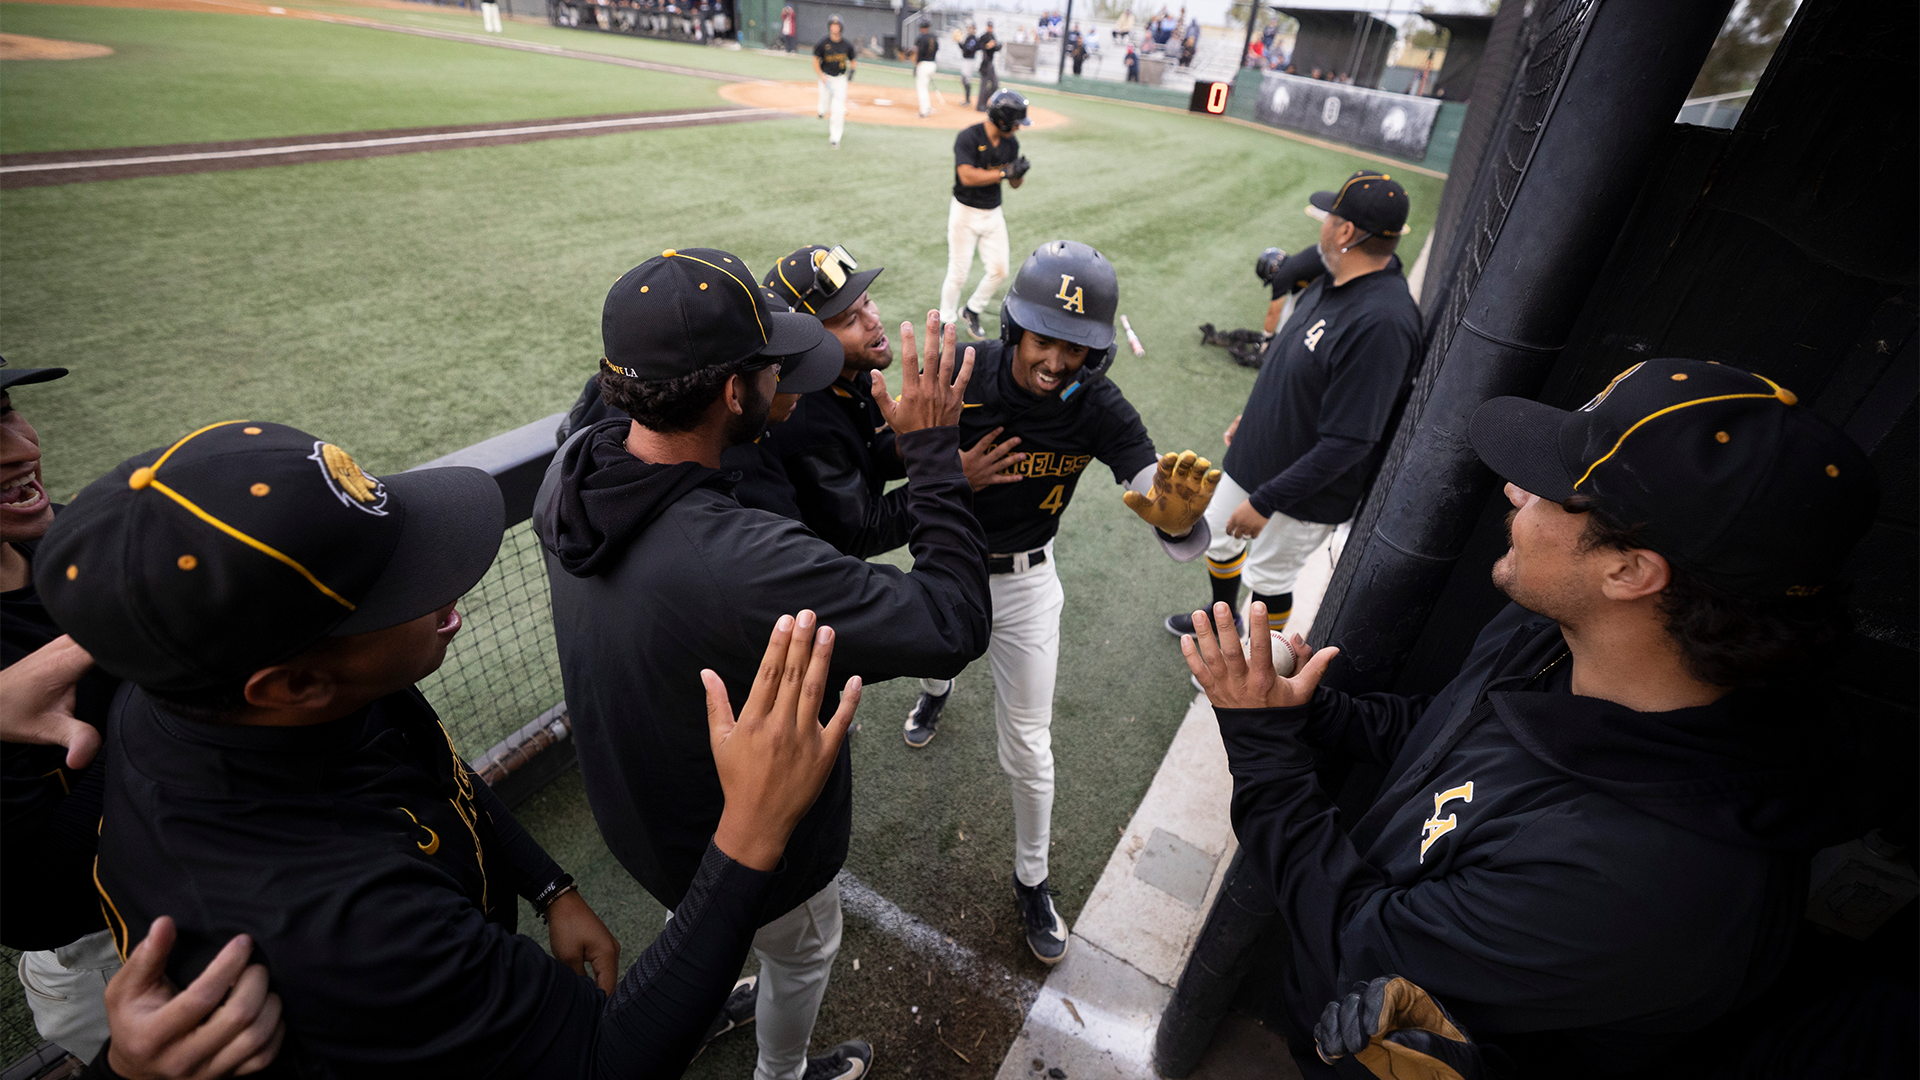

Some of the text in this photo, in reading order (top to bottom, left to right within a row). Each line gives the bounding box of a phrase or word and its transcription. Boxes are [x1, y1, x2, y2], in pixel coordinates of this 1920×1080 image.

[1206, 81, 1229, 115] 0
[1055, 273, 1085, 314] LA
[1303, 318, 1327, 352] LA
[624, 367, 639, 378] LA
[987, 443, 1092, 478] NGELES
[1038, 484, 1065, 515] 4
[1419, 780, 1474, 864] LA
